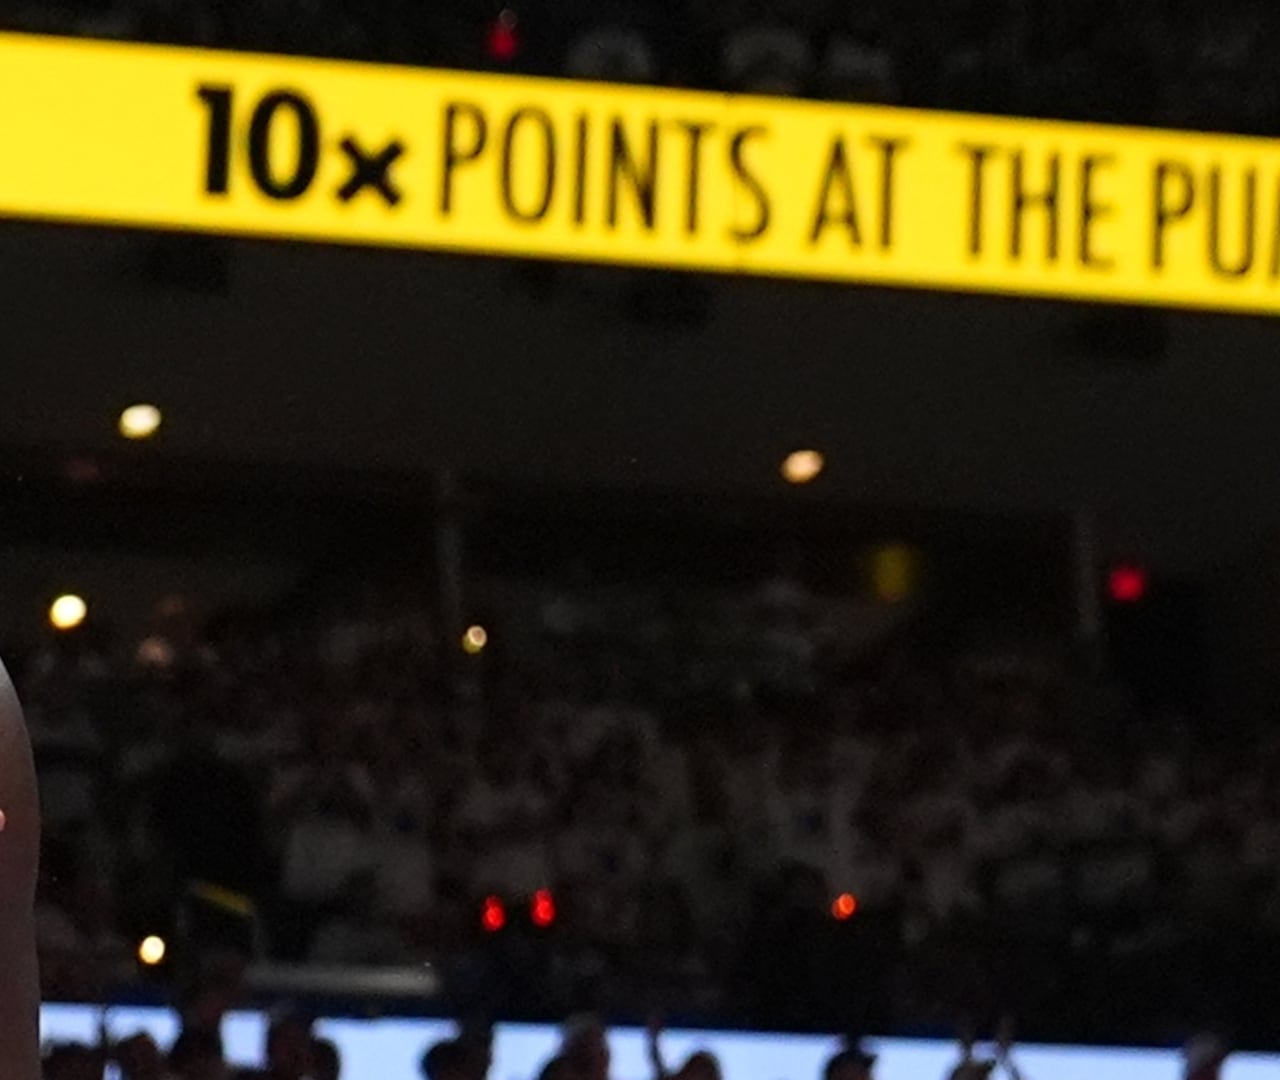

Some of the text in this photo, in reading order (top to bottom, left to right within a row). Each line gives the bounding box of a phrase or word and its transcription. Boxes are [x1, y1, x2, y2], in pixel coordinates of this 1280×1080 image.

[440, 100, 772, 244] POINTS
[808, 134, 910, 250] AT
[956, 144, 1117, 272] THE
[1151, 160, 1280, 284] PU
